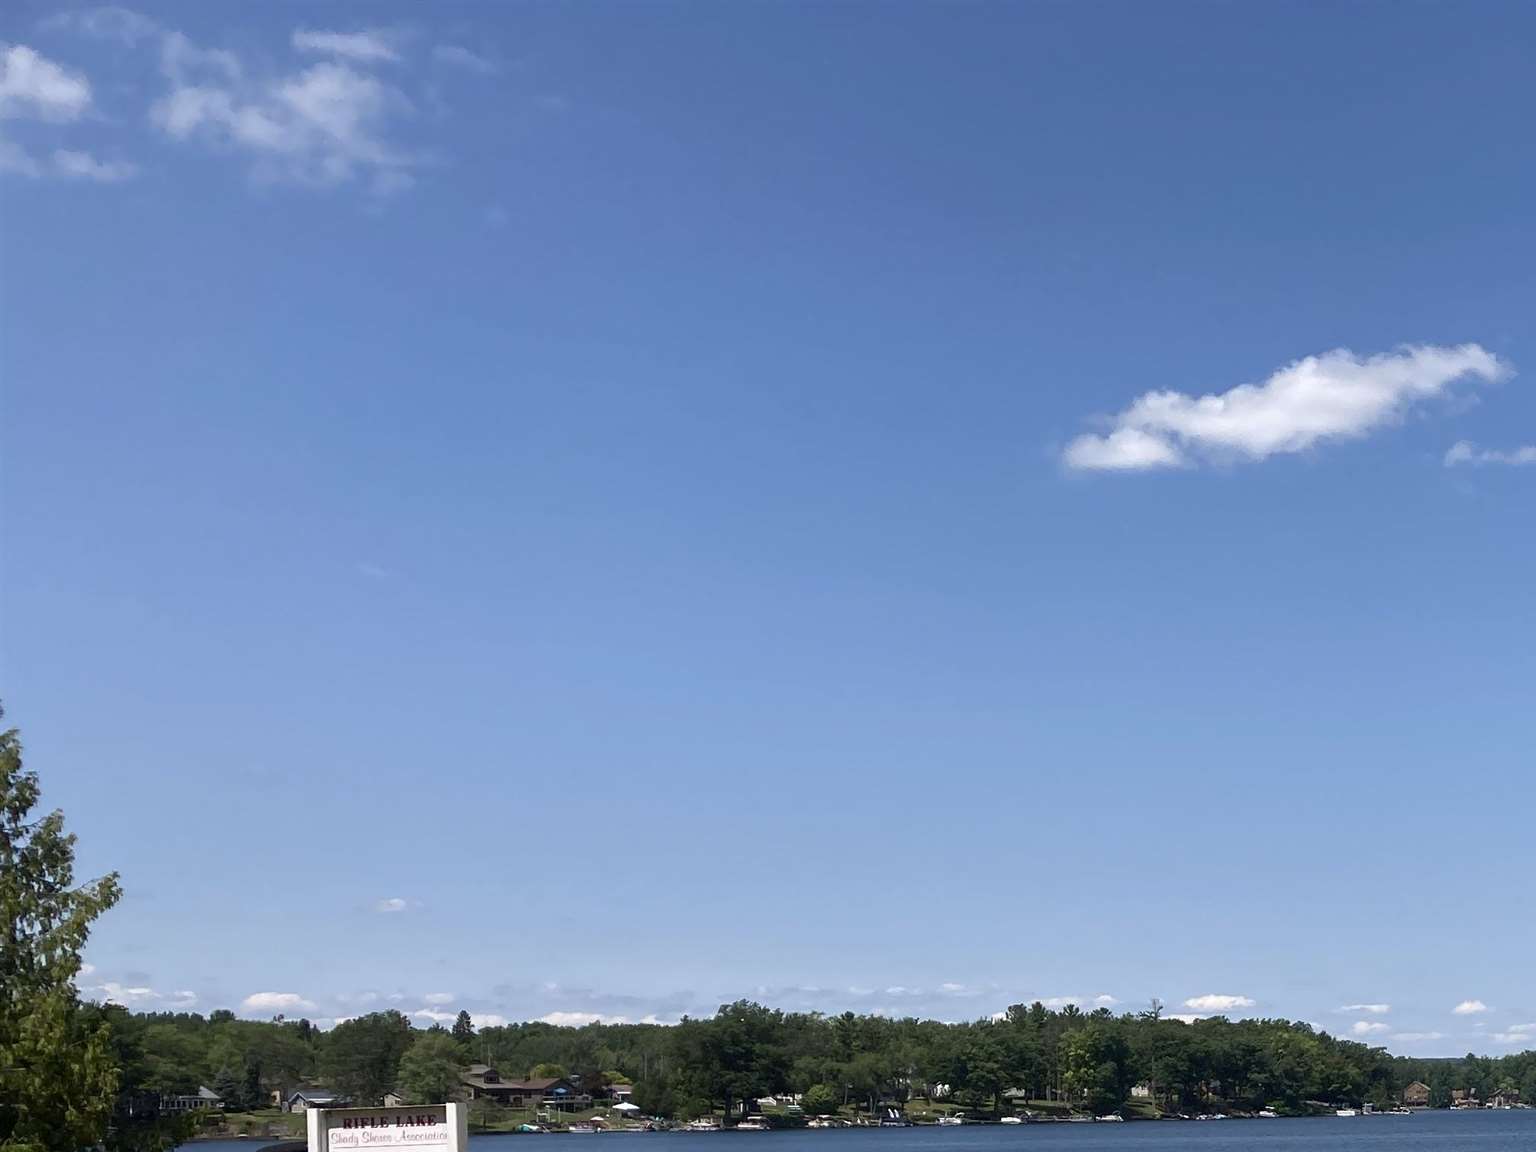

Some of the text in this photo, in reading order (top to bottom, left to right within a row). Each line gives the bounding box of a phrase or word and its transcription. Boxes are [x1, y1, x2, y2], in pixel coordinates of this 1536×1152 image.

[343, 1114, 437, 1129] RIFLE LAKE
[330, 1132, 359, 1145] Shady
[361, 1131, 392, 1144] Shores
